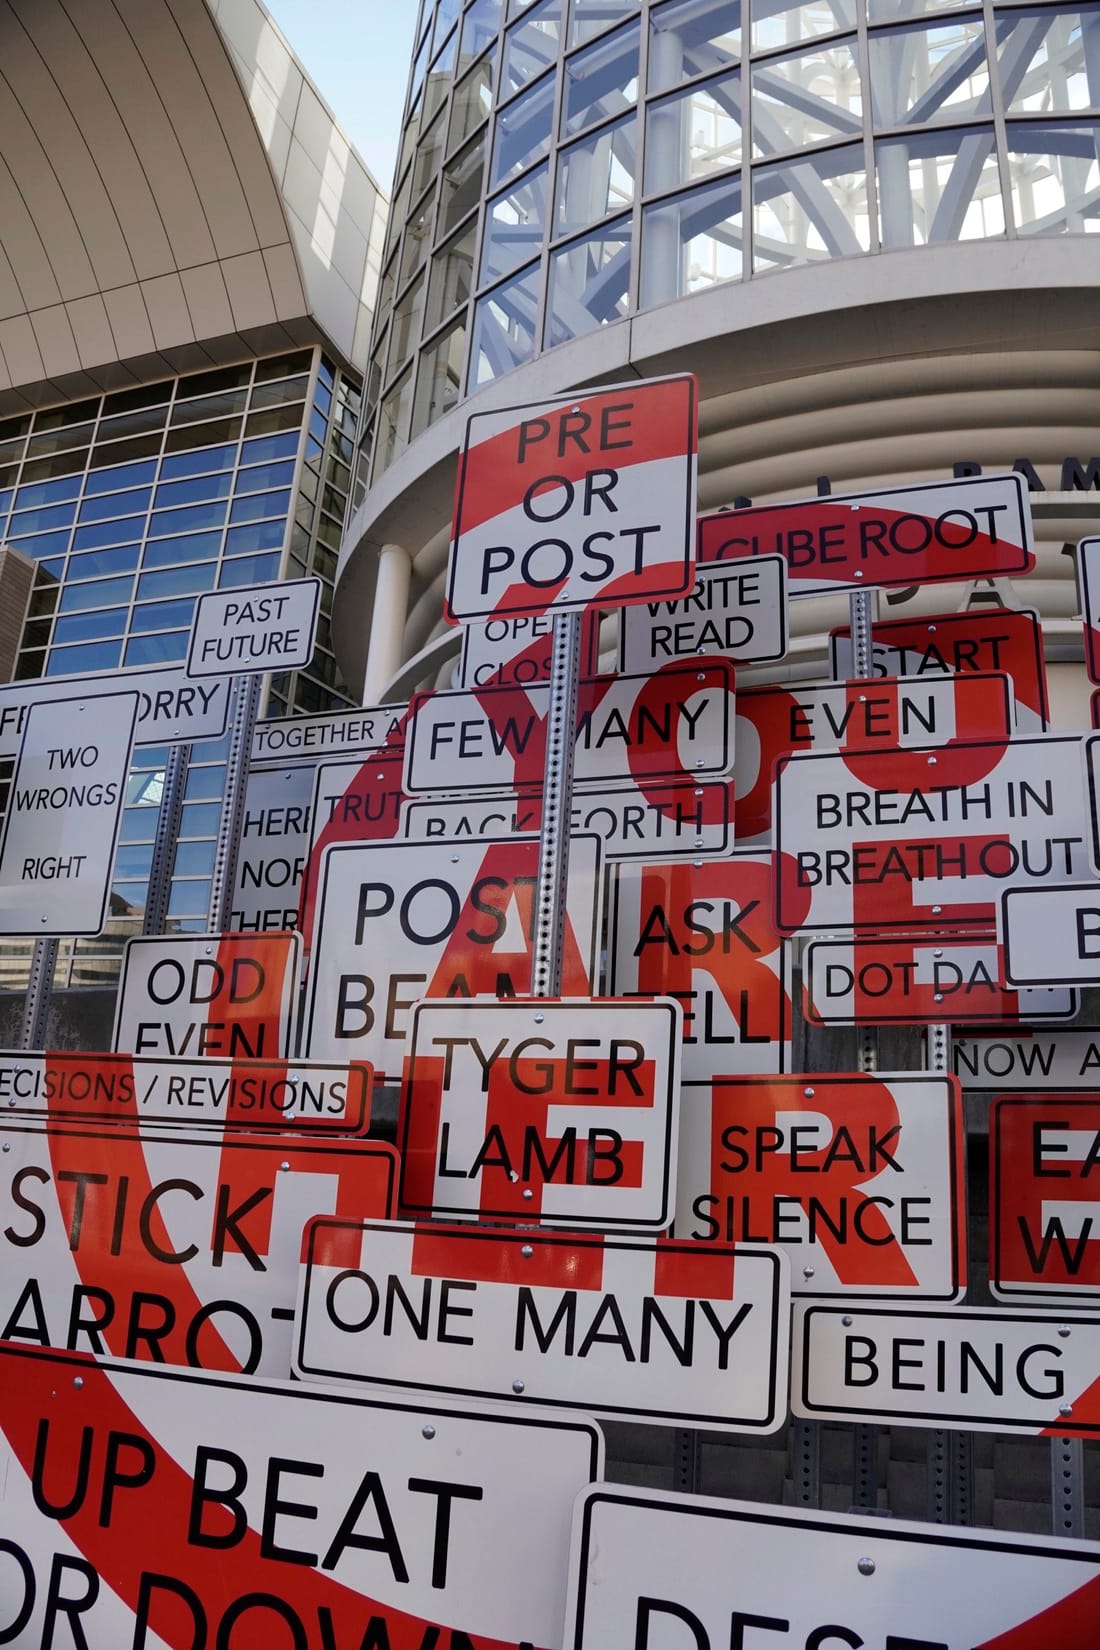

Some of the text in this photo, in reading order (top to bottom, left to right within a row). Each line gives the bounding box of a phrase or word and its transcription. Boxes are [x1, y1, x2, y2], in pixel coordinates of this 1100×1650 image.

[517, 403, 634, 464] PRE
[522, 468, 619, 523] OR
[480, 525, 661, 595] POST
[715, 504, 1008, 568] CUBE ROOT
[222, 597, 290, 626] PAST
[200, 629, 300, 662] FUTURE
[651, 616, 755, 657] READ
[872, 635, 1009, 679] START
[256, 720, 374, 751] TOGETHER
[430, 715, 536, 760] FEW
[790, 695, 935, 742] EVEN
[47, 746, 99, 771] TWO
[16, 783, 117, 811] WRONGS
[816, 779, 1053, 829] BREATH IN
[22, 856, 87, 880] RIGHT
[797, 837, 1082, 888] BREATH OUT
[633, 900, 761, 957] ASK
[147, 958, 266, 1005] ODD
[825, 962, 919, 998] DOT
[135, 1023, 265, 1058] EVEN
[953, 1043, 1056, 1076] NOW
[432, 1037, 645, 1097] TYGER
[167, 1076, 347, 1113] REVISIONS
[438, 1122, 624, 1186] LAMB
[719, 1125, 904, 1174] SPEAK
[4, 1166, 273, 1271] STICK
[690, 1195, 933, 1246] SILENCE
[326, 1269, 754, 1371] ONE MANY
[844, 1335, 1065, 1400] BEING
[31, 1418, 483, 1590] UP BEAT
